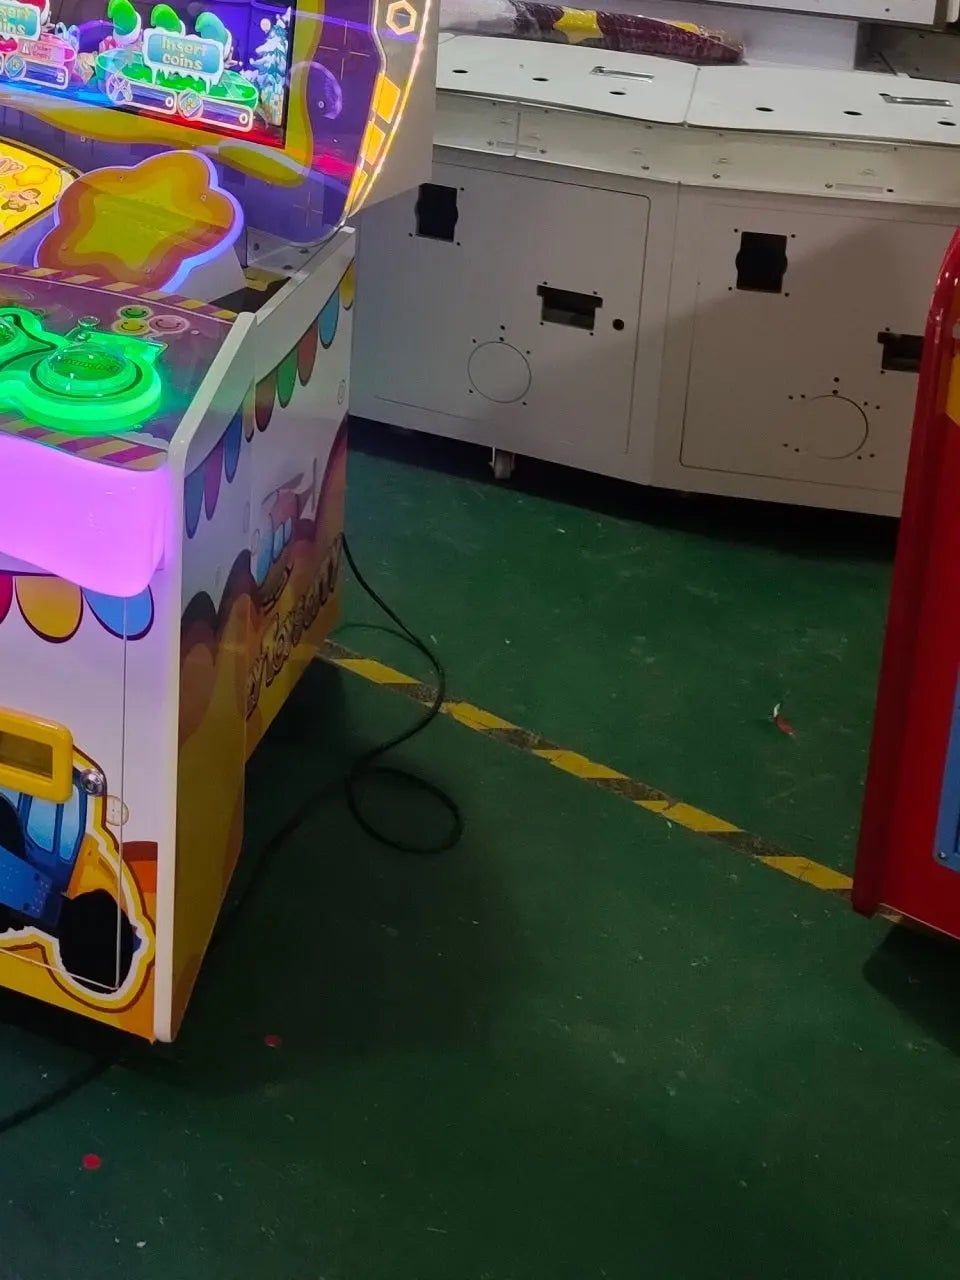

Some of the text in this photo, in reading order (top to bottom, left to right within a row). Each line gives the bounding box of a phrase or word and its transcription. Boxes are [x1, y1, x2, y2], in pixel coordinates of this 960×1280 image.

[161, 36, 209, 57] Insert
[162, 52, 203, 71] coins
[165, 96, 174, 108] 0
[239, 112, 249, 125] 0
